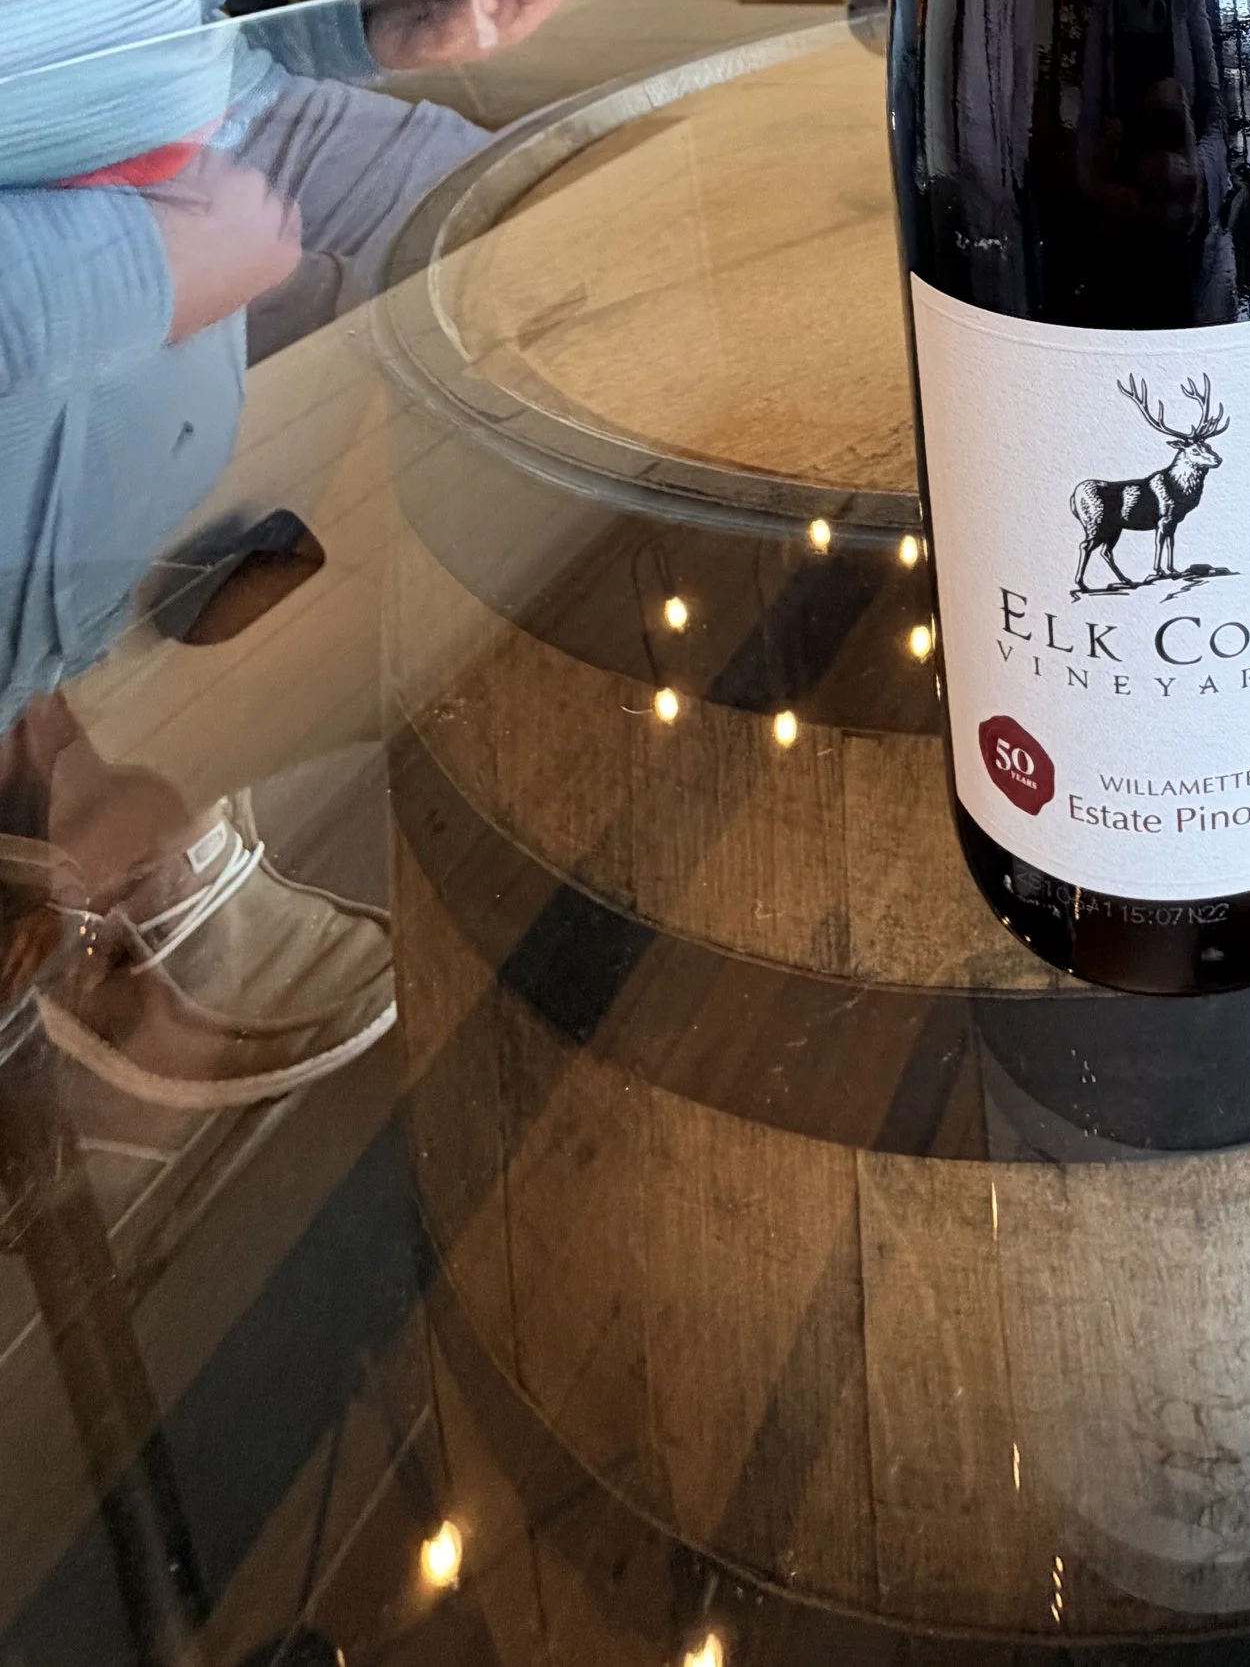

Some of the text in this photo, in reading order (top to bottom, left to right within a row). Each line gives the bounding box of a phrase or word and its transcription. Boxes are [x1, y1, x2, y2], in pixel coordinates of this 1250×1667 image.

[999, 586, 1123, 663] ELK
[995, 738, 1036, 775] 50
[1010, 771, 1038, 790] YEARS
[1068, 793, 1162, 834] Estate
[1122, 905, 1184, 925] 15:07
